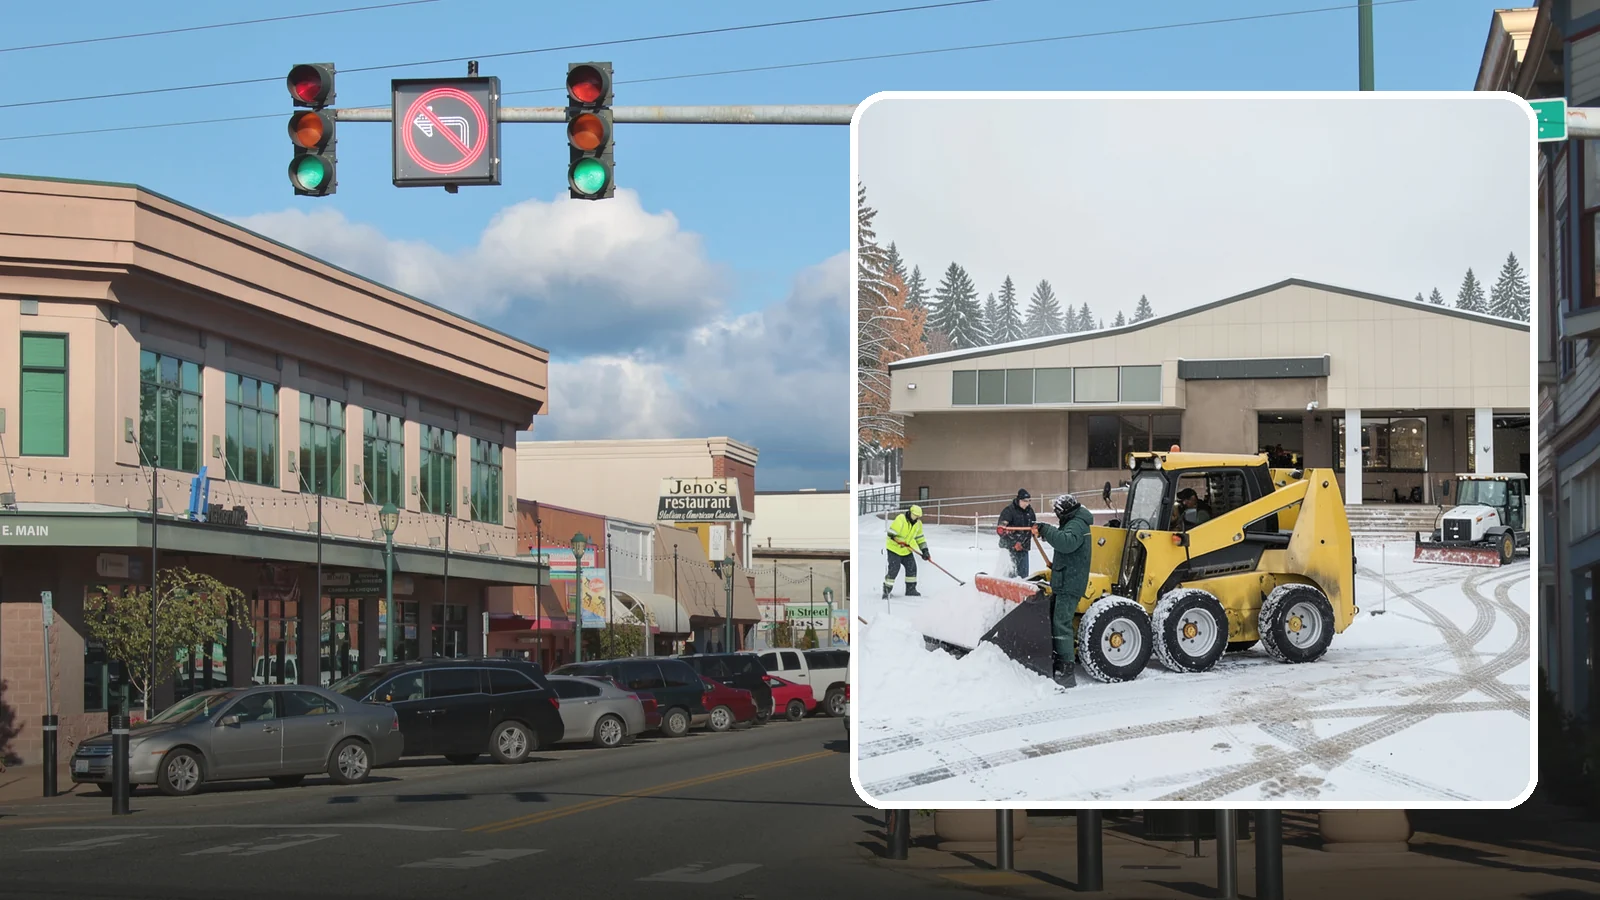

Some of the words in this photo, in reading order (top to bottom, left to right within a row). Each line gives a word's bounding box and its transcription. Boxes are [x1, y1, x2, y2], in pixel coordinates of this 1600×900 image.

[670, 480, 727, 494] Jeno's
[665, 496, 731, 509] restaurant
[658, 510, 681, 519] Italian
[686, 510, 714, 519] American
[715, 509, 737, 519] Cuisine
[2, 525, 13, 536] E.
[15, 525, 49, 536] MAIN
[785, 607, 795, 617] in
[797, 607, 828, 617] Street
[789, 619, 824, 627] lass
